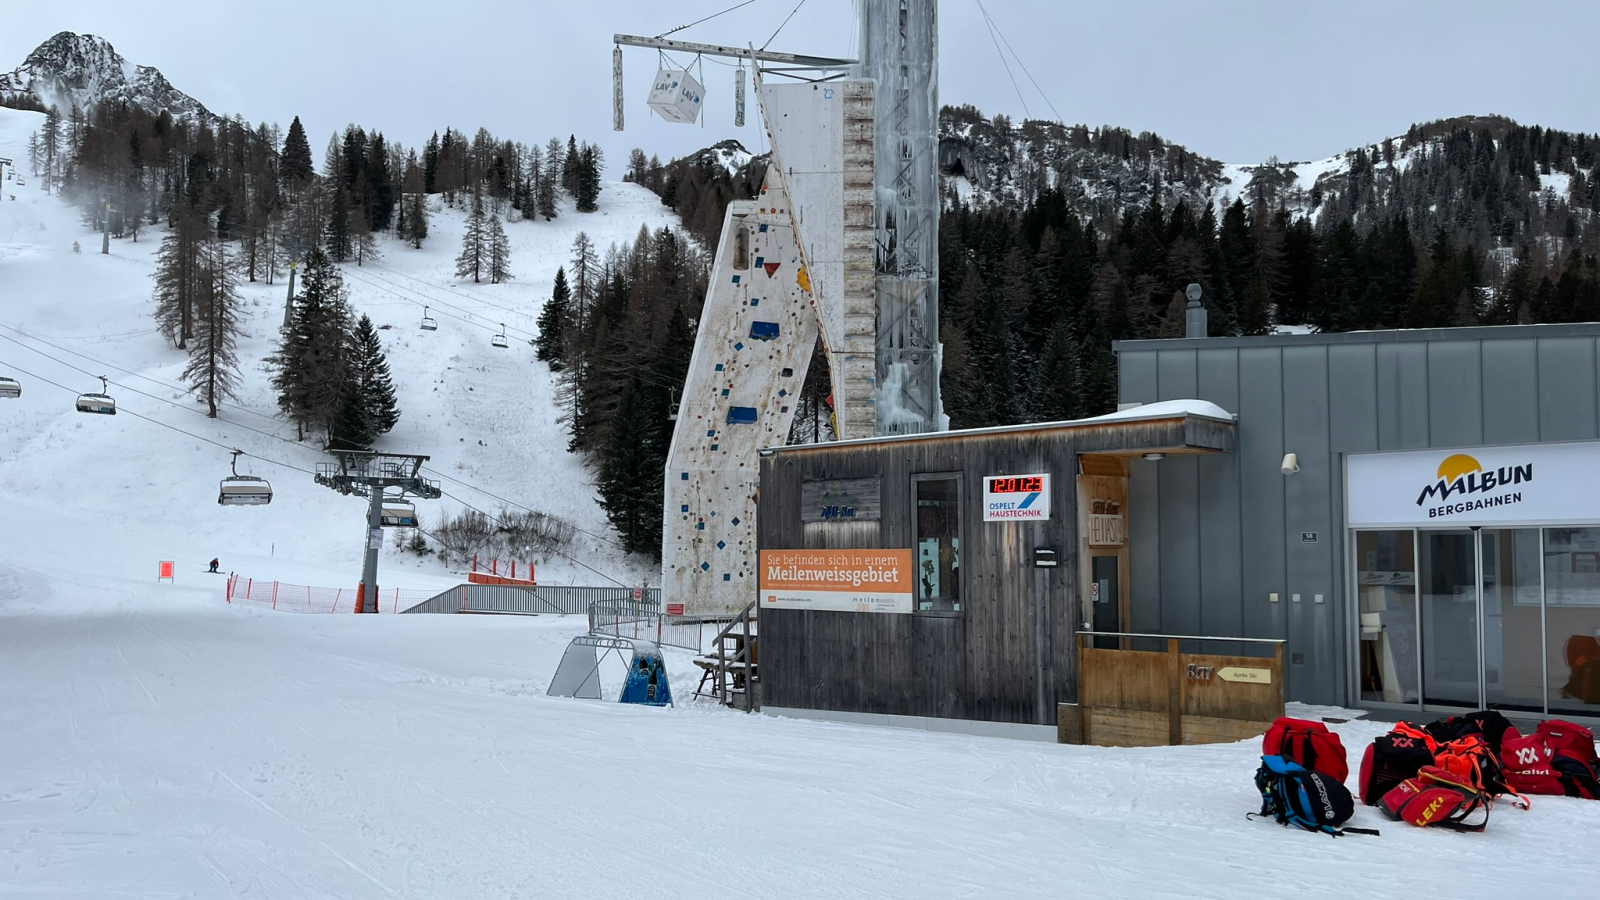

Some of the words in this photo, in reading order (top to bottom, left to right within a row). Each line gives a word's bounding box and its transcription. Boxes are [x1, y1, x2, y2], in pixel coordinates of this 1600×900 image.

[1416, 462, 1533, 507] MALBUN
[989, 502, 1015, 510] OSPELT
[989, 509, 1042, 518] HAUSTECHNIK
[1428, 492, 1523, 518] BERGBAHNEN
[768, 555, 780, 565] Sie
[784, 554, 825, 565] befinden
[828, 554, 848, 565] sich
[852, 555, 862, 565] in
[865, 556, 898, 565] einem
[767, 566, 899, 586] Meilenweissgebiet
[1187, 663, 1214, 680] Bar
[1416, 796, 1444, 827] LEKI
